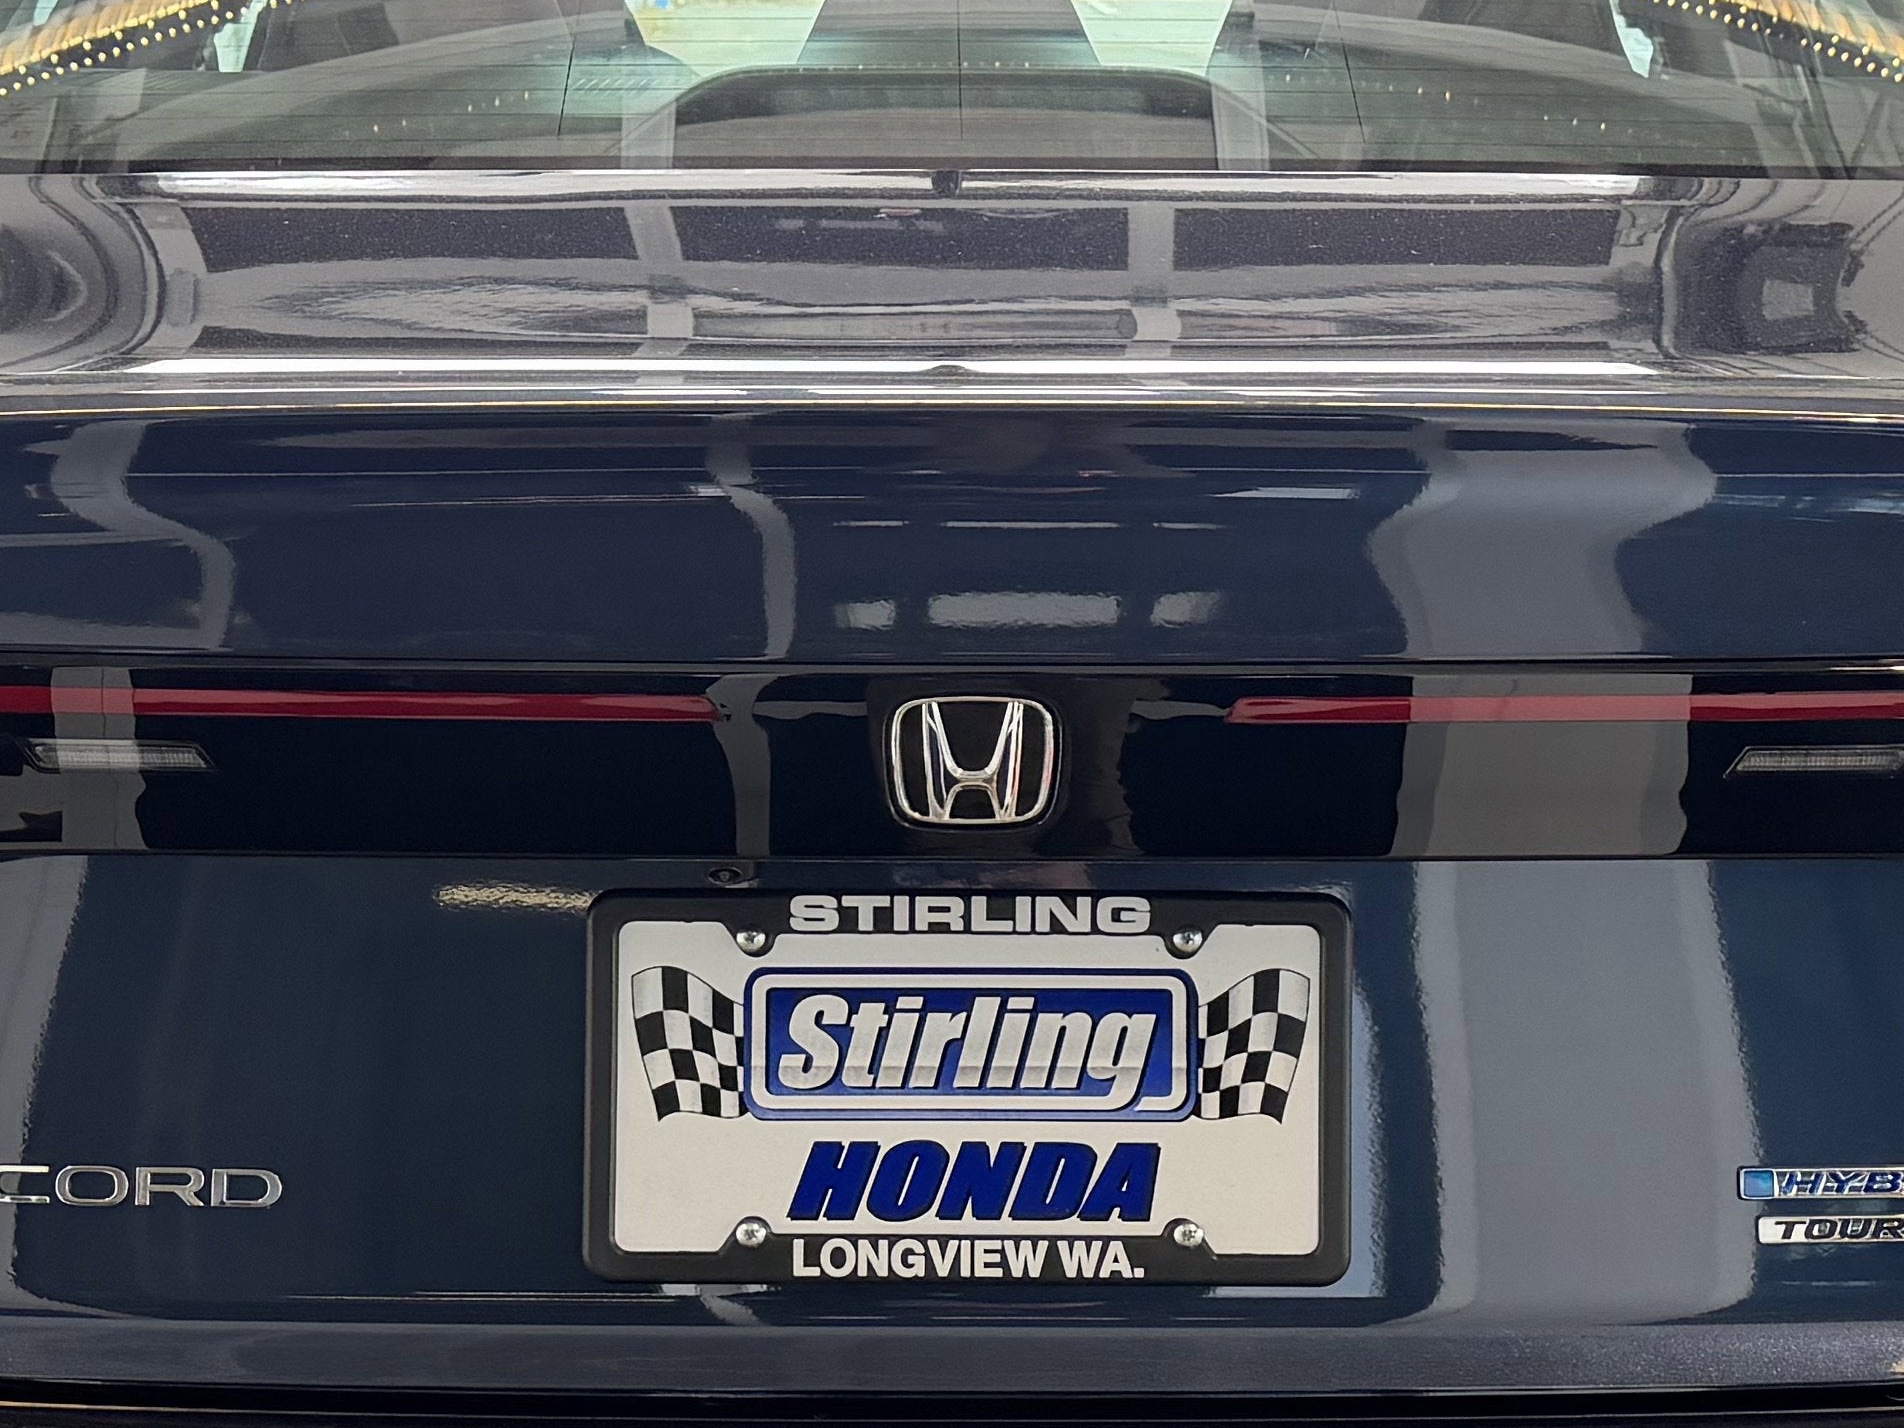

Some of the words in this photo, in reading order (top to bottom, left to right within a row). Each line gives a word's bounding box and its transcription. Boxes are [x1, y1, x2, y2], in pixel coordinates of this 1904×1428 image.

[789, 894, 1152, 933] STIRLING
[777, 993, 1157, 1112] Stirling
[786, 1139, 1162, 1223] HONDA
[792, 1237, 1049, 1279] LONGVIEW
[1057, 1239, 1146, 1279] WA.
